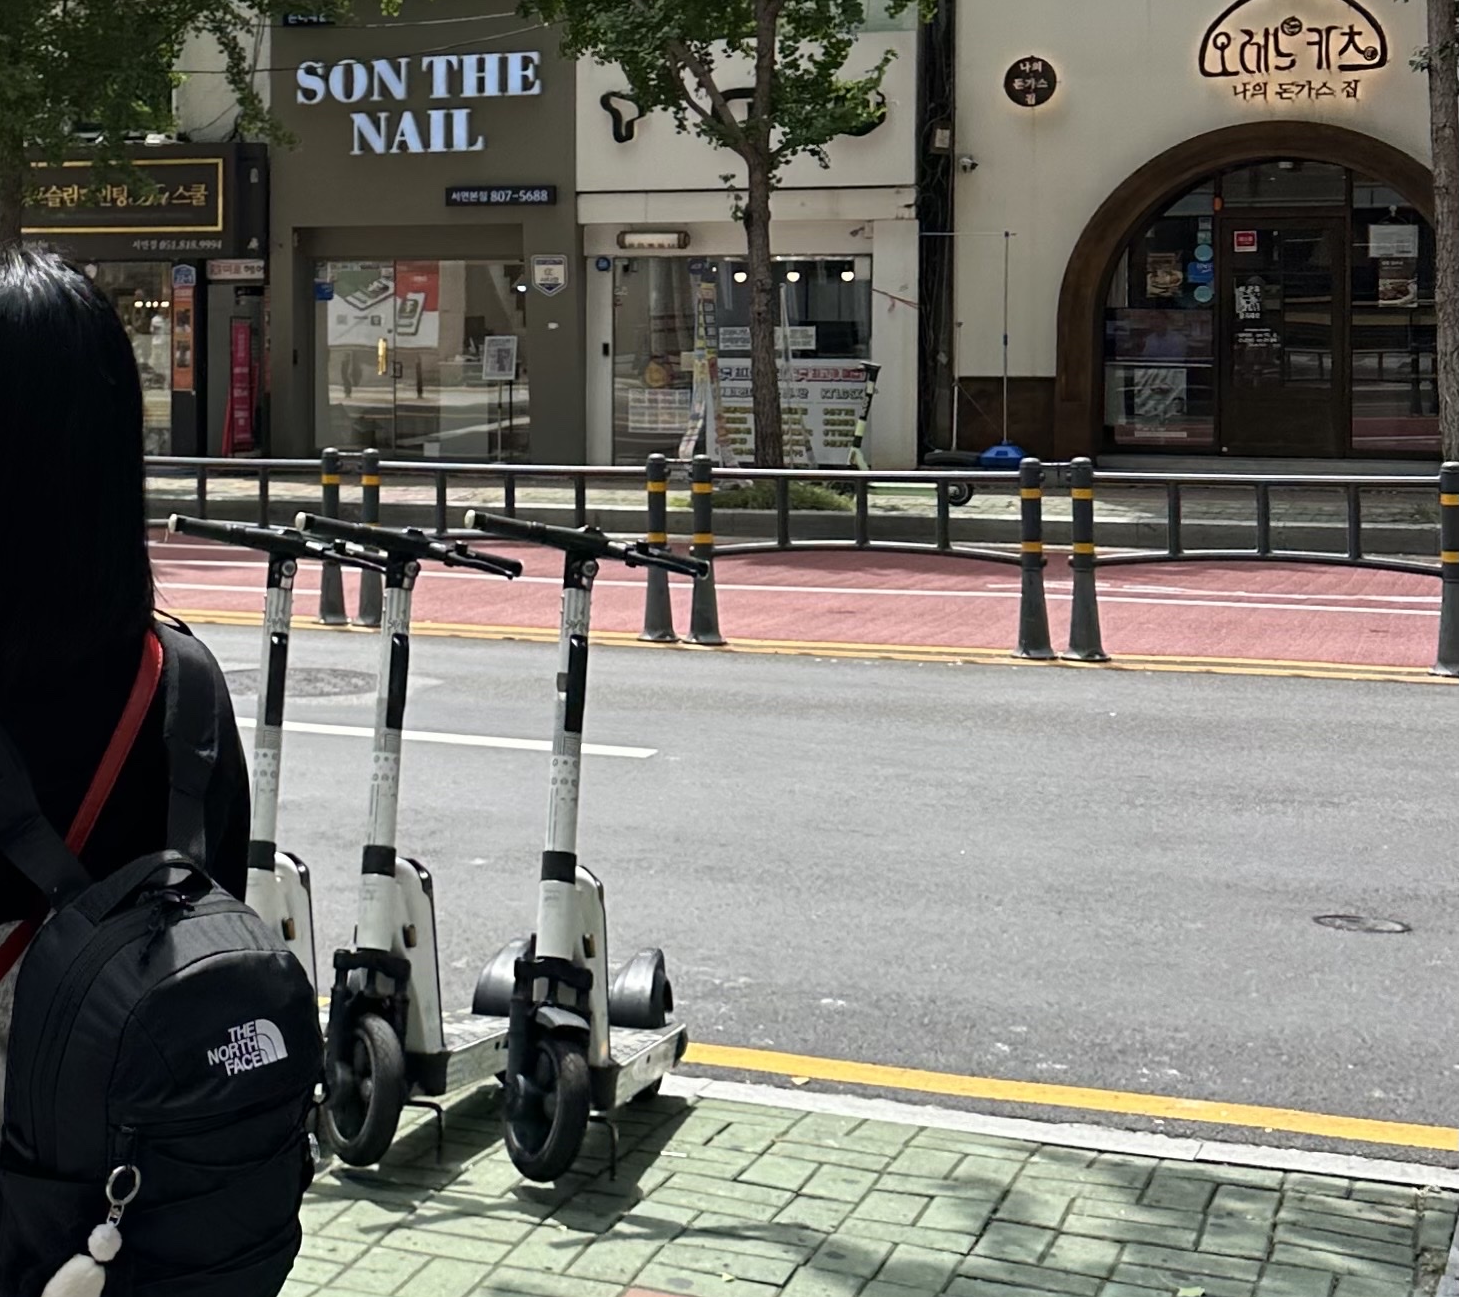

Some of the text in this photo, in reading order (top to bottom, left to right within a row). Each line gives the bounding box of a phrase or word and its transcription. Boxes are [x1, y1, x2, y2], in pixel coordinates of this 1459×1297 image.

[296, 51, 542, 105] SON THE
[1232, 79, 1362, 101] 나의 돈가스 집
[350, 108, 486, 155] NAIL
[171, 183, 208, 207] 스쿨
[489, 189, 550, 203] 807-5688
[228, 1021, 256, 1043] THE
[207, 1035, 259, 1066] NORTH
[225, 1050, 264, 1077] FACE
